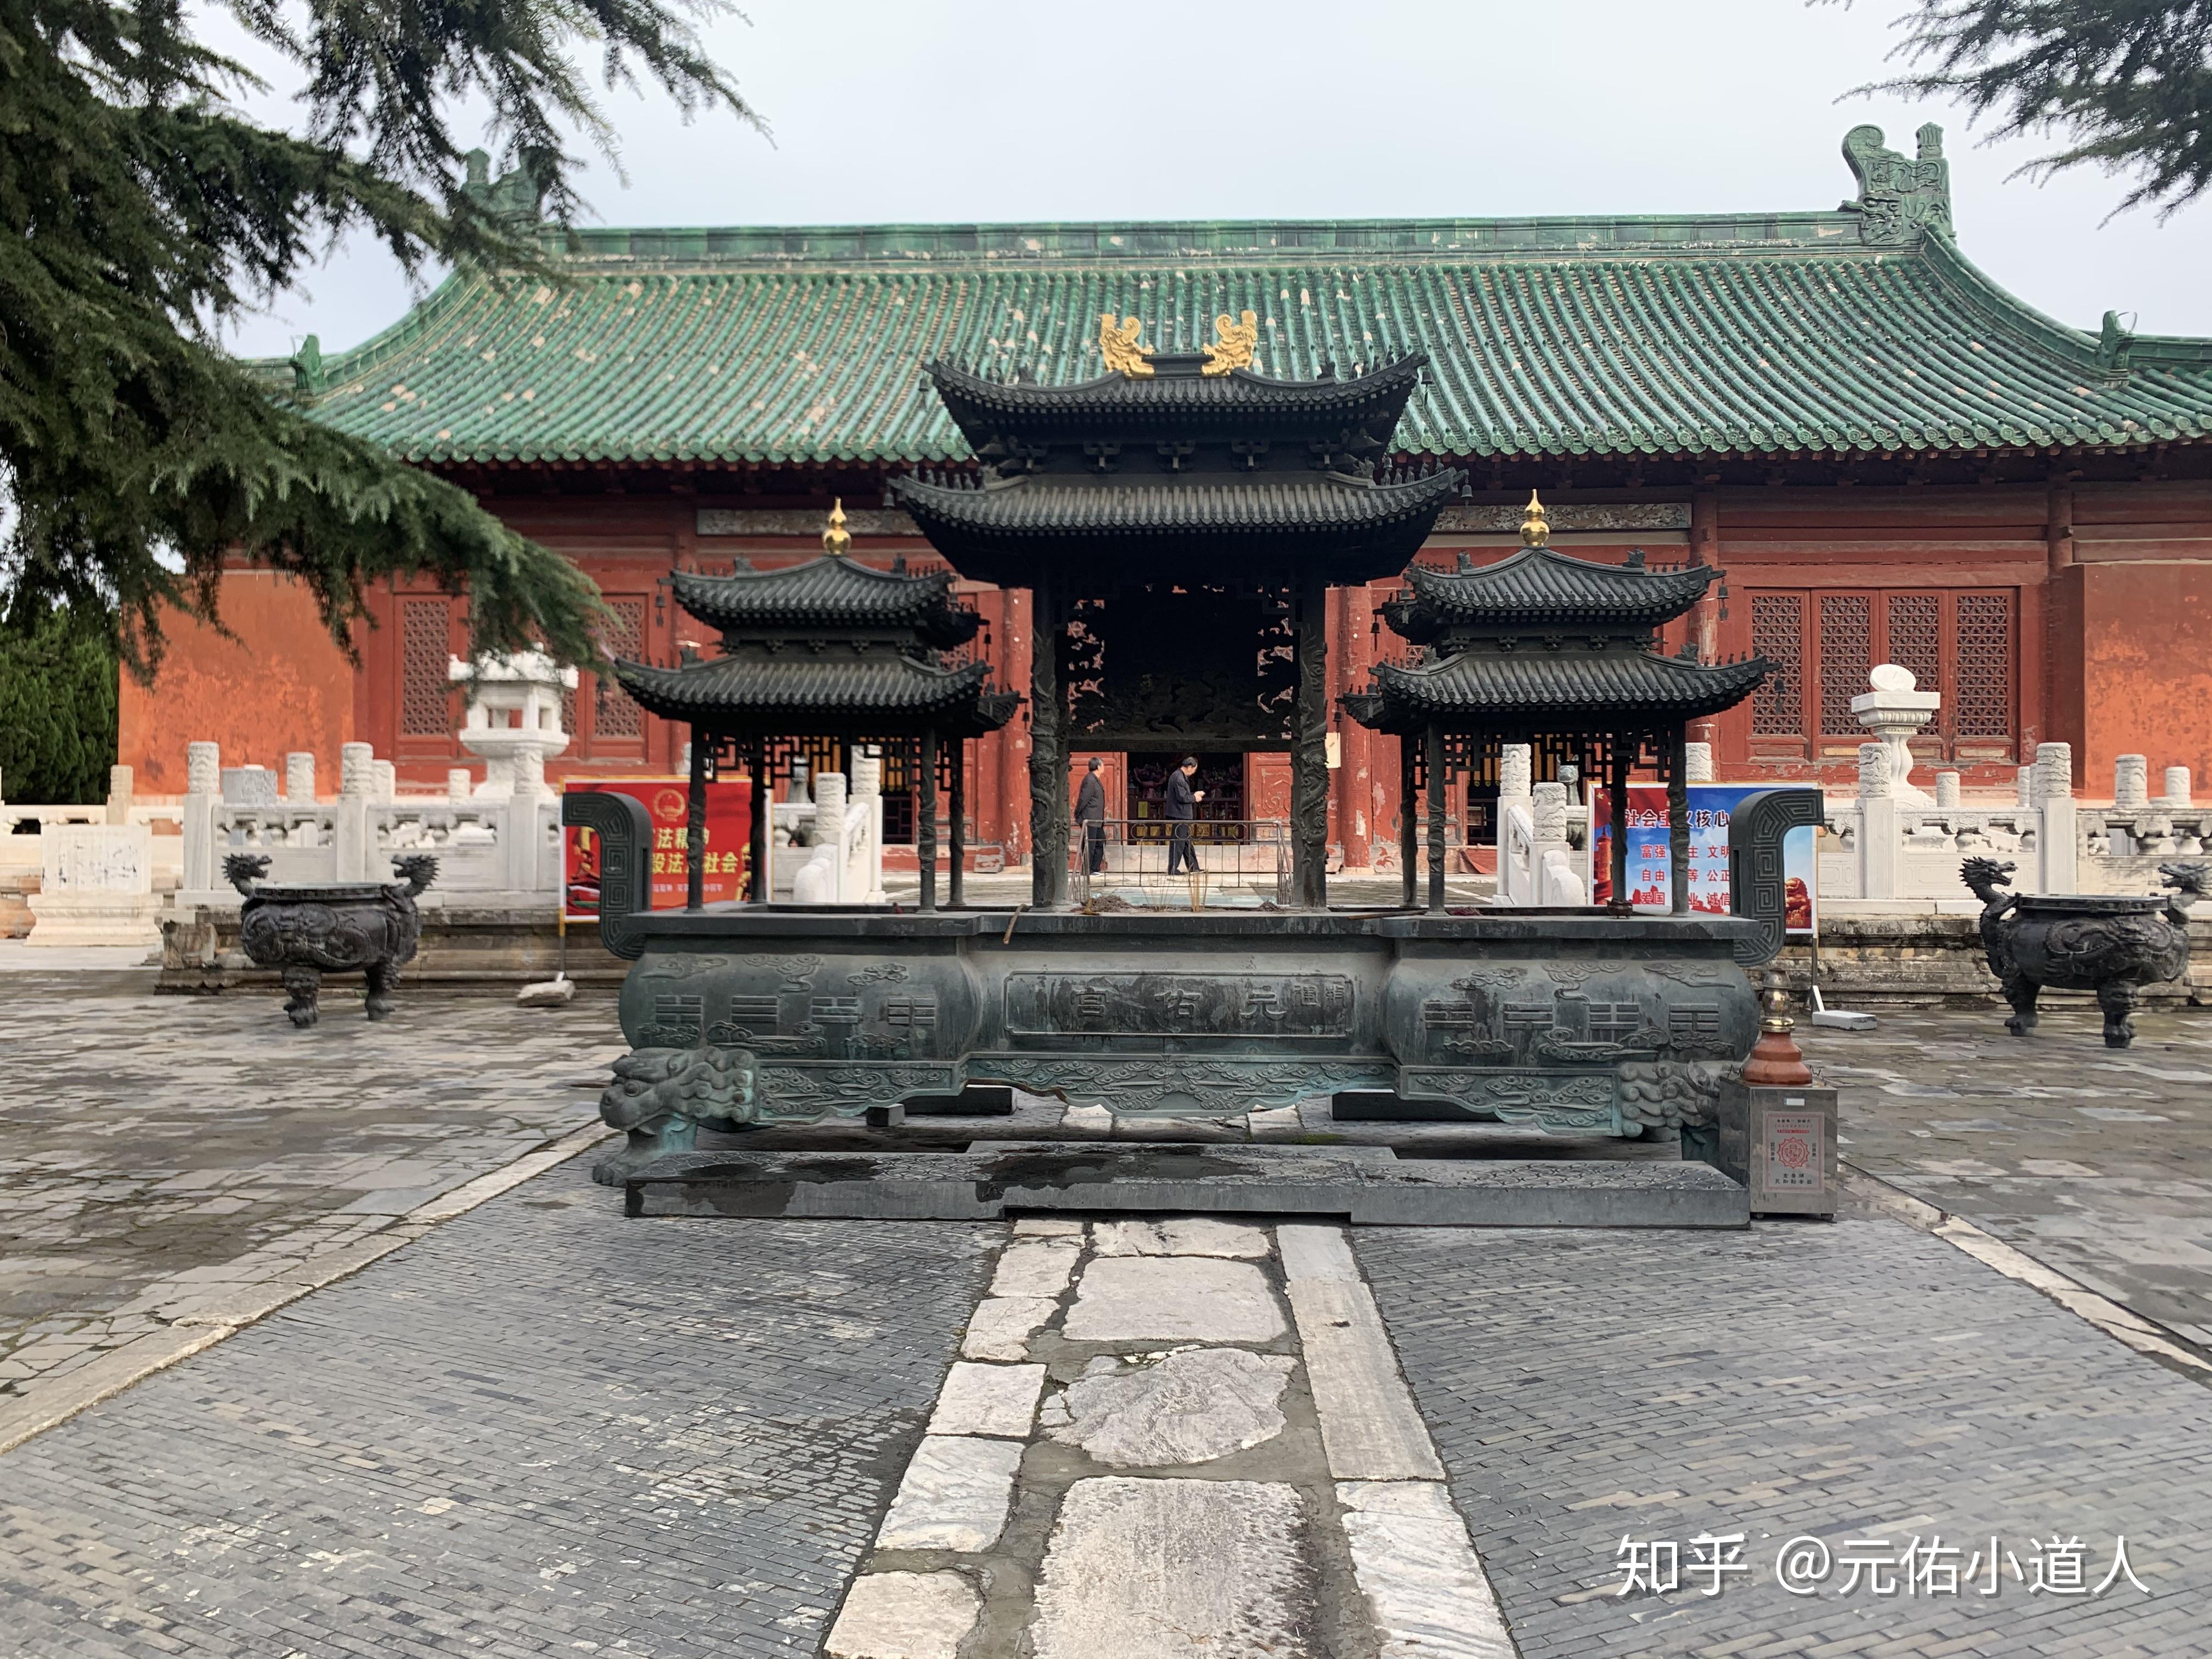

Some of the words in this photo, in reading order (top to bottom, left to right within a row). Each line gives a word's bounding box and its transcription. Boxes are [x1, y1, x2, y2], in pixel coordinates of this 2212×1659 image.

[653, 827, 710, 849] 法精
[1641, 845, 1666, 858] 富强
[1707, 845, 1729, 858] 文明
[652, 851, 738, 874] 设法社会
[1643, 869, 1665, 882] 自由
[1707, 869, 1729, 882] 公正
[1641, 892, 1666, 904] 爱国
[1707, 892, 1730, 906] 诚信
